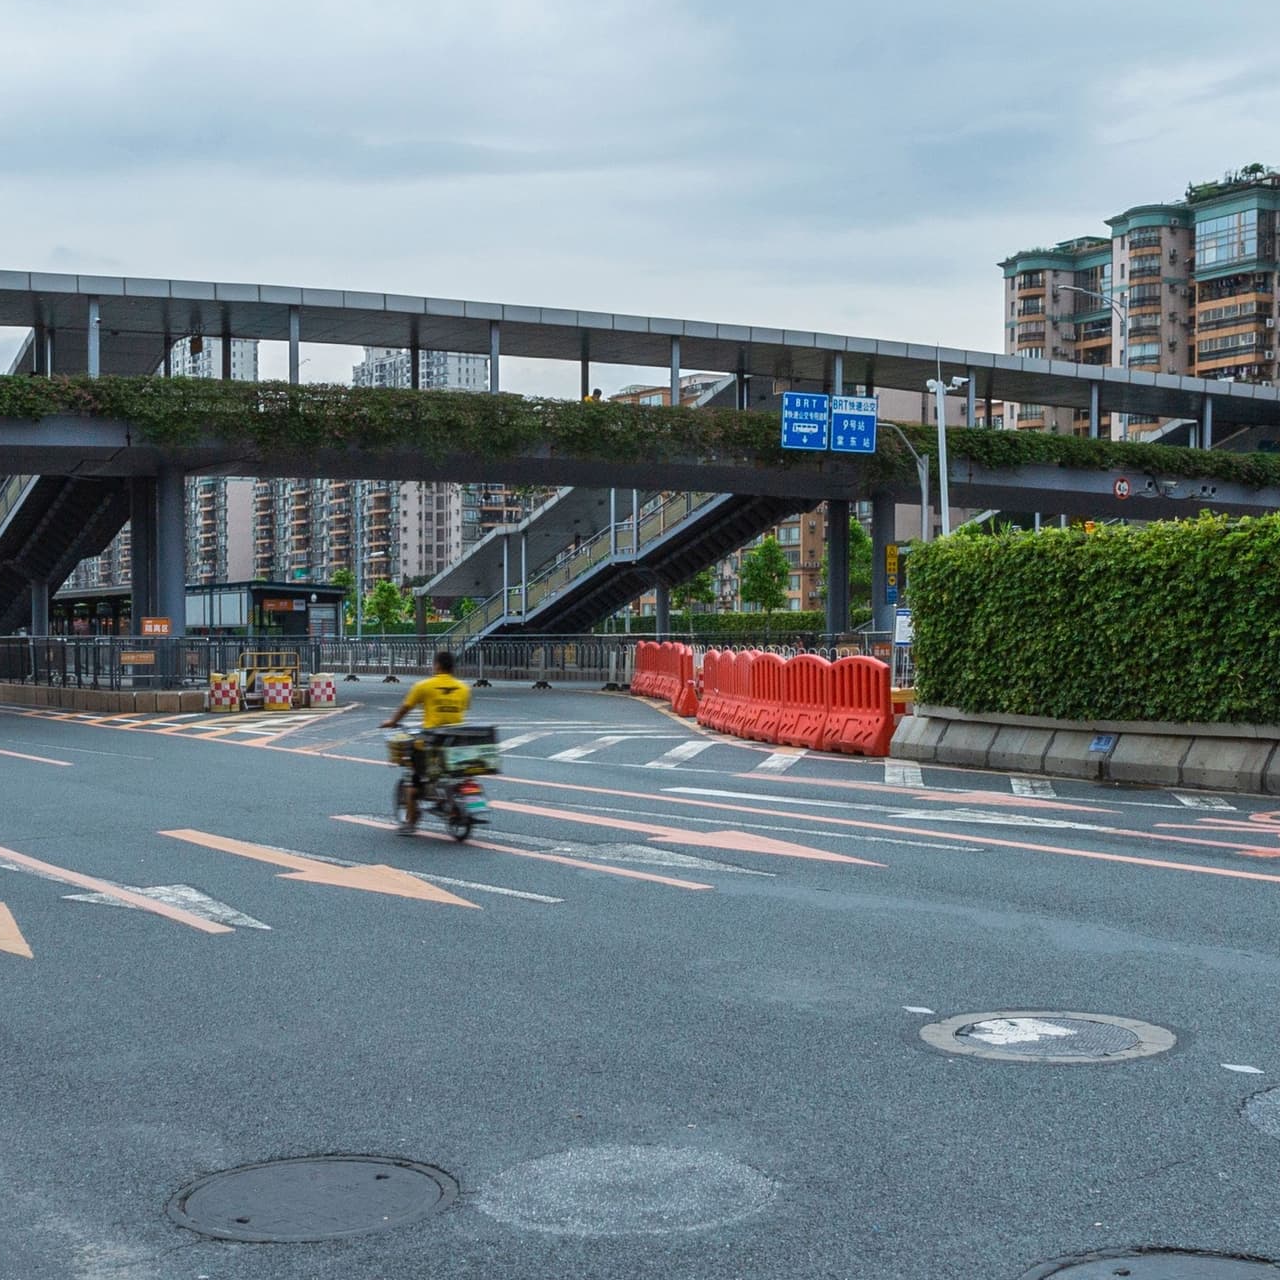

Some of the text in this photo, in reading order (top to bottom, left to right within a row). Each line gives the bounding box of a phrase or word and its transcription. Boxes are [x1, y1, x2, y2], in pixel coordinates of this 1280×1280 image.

[795, 398, 817, 408] BRT
[833, 399, 876, 411] BRT快速公交
[843, 420, 865, 431] 9号站
